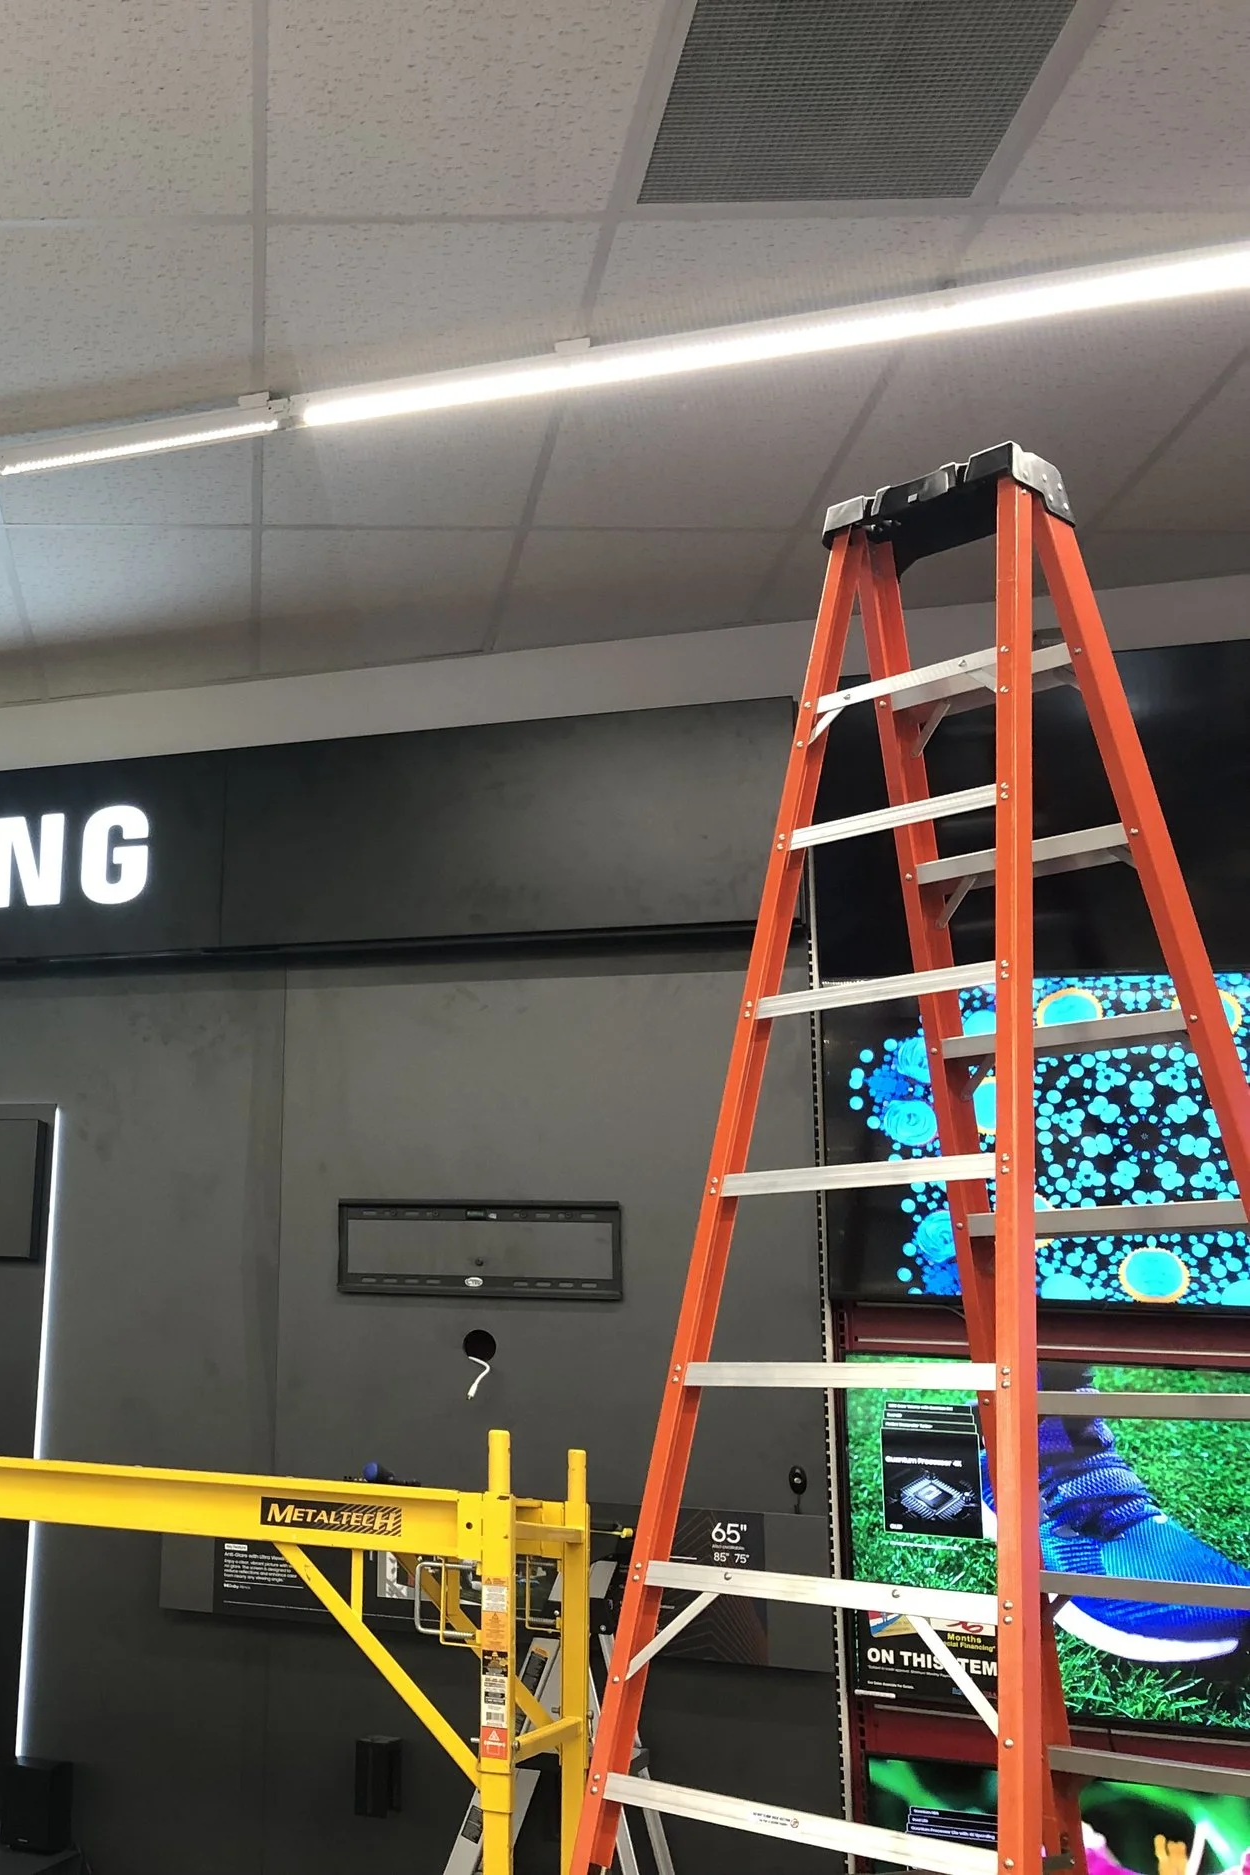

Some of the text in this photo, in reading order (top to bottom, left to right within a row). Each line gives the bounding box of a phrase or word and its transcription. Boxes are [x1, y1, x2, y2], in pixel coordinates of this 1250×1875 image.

[267, 1503, 396, 1531] METALTECH
[711, 1522, 748, 1544] 65"
[713, 1552, 750, 1564] 85" 75"
[947, 1632, 982, 1644] Months
[866, 1647, 998, 1677] ON THIS TEM
